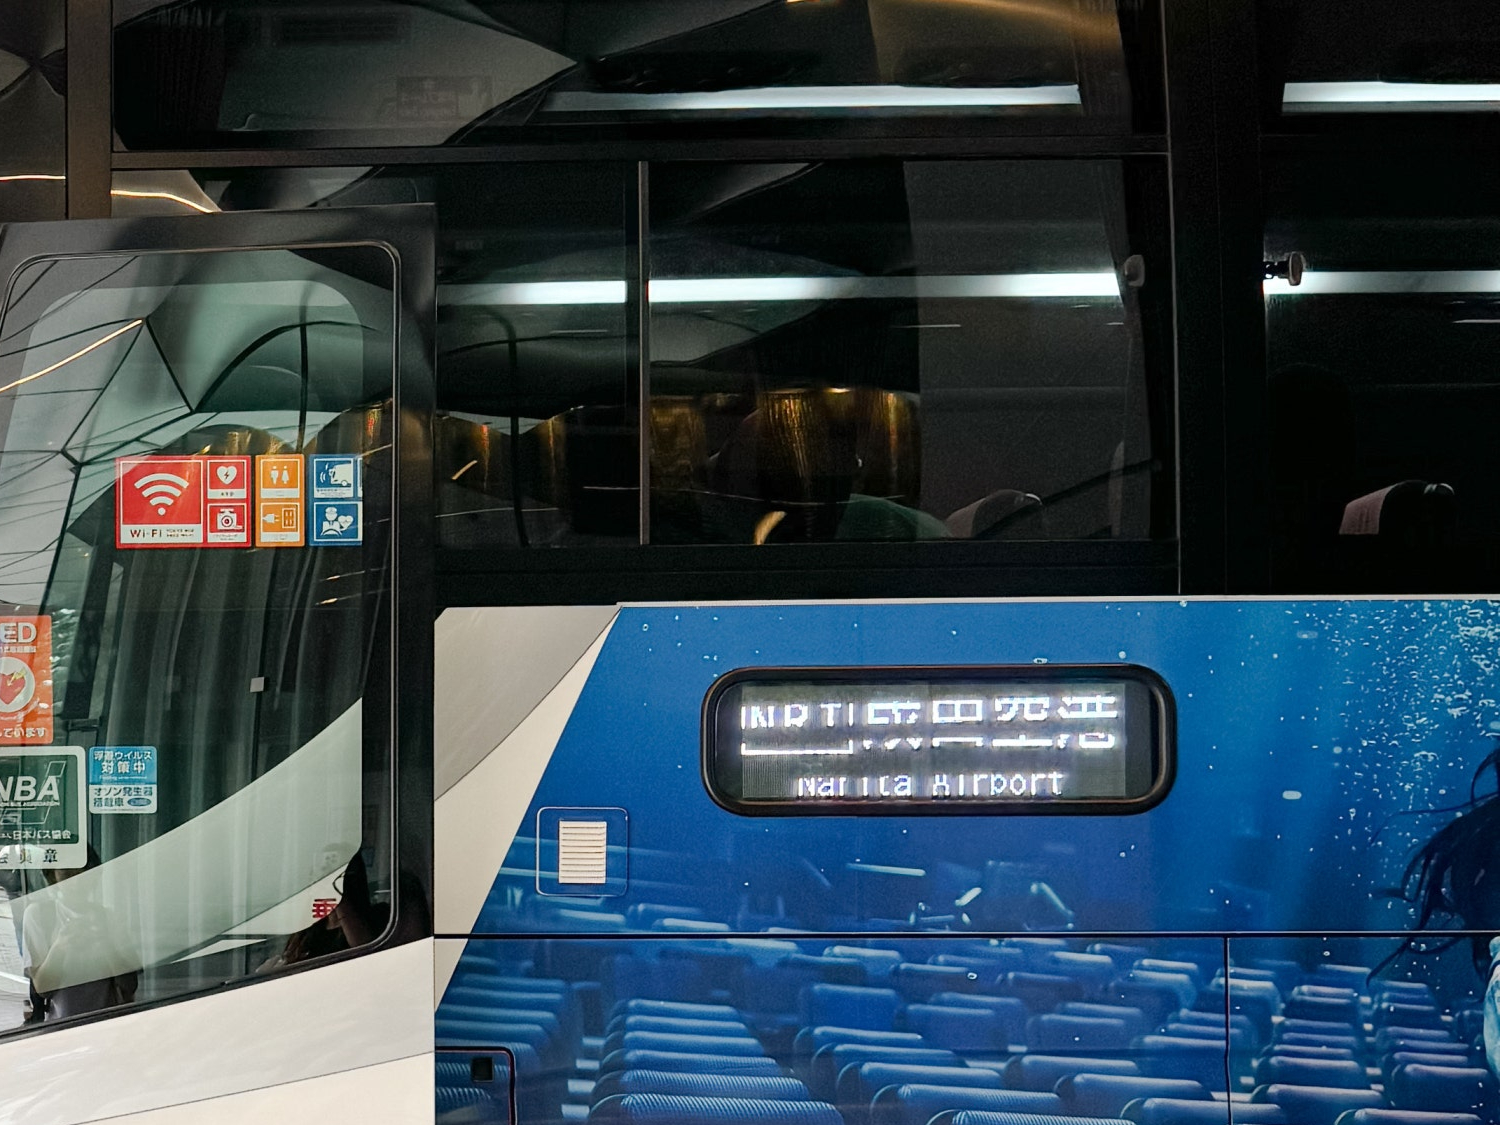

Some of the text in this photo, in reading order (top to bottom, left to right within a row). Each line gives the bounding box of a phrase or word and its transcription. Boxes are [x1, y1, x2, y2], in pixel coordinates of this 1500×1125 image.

[130, 528, 162, 538] Wi-Fi
[101, 761, 146, 774] 対策中
[797, 771, 1065, 797] Narita Airport
